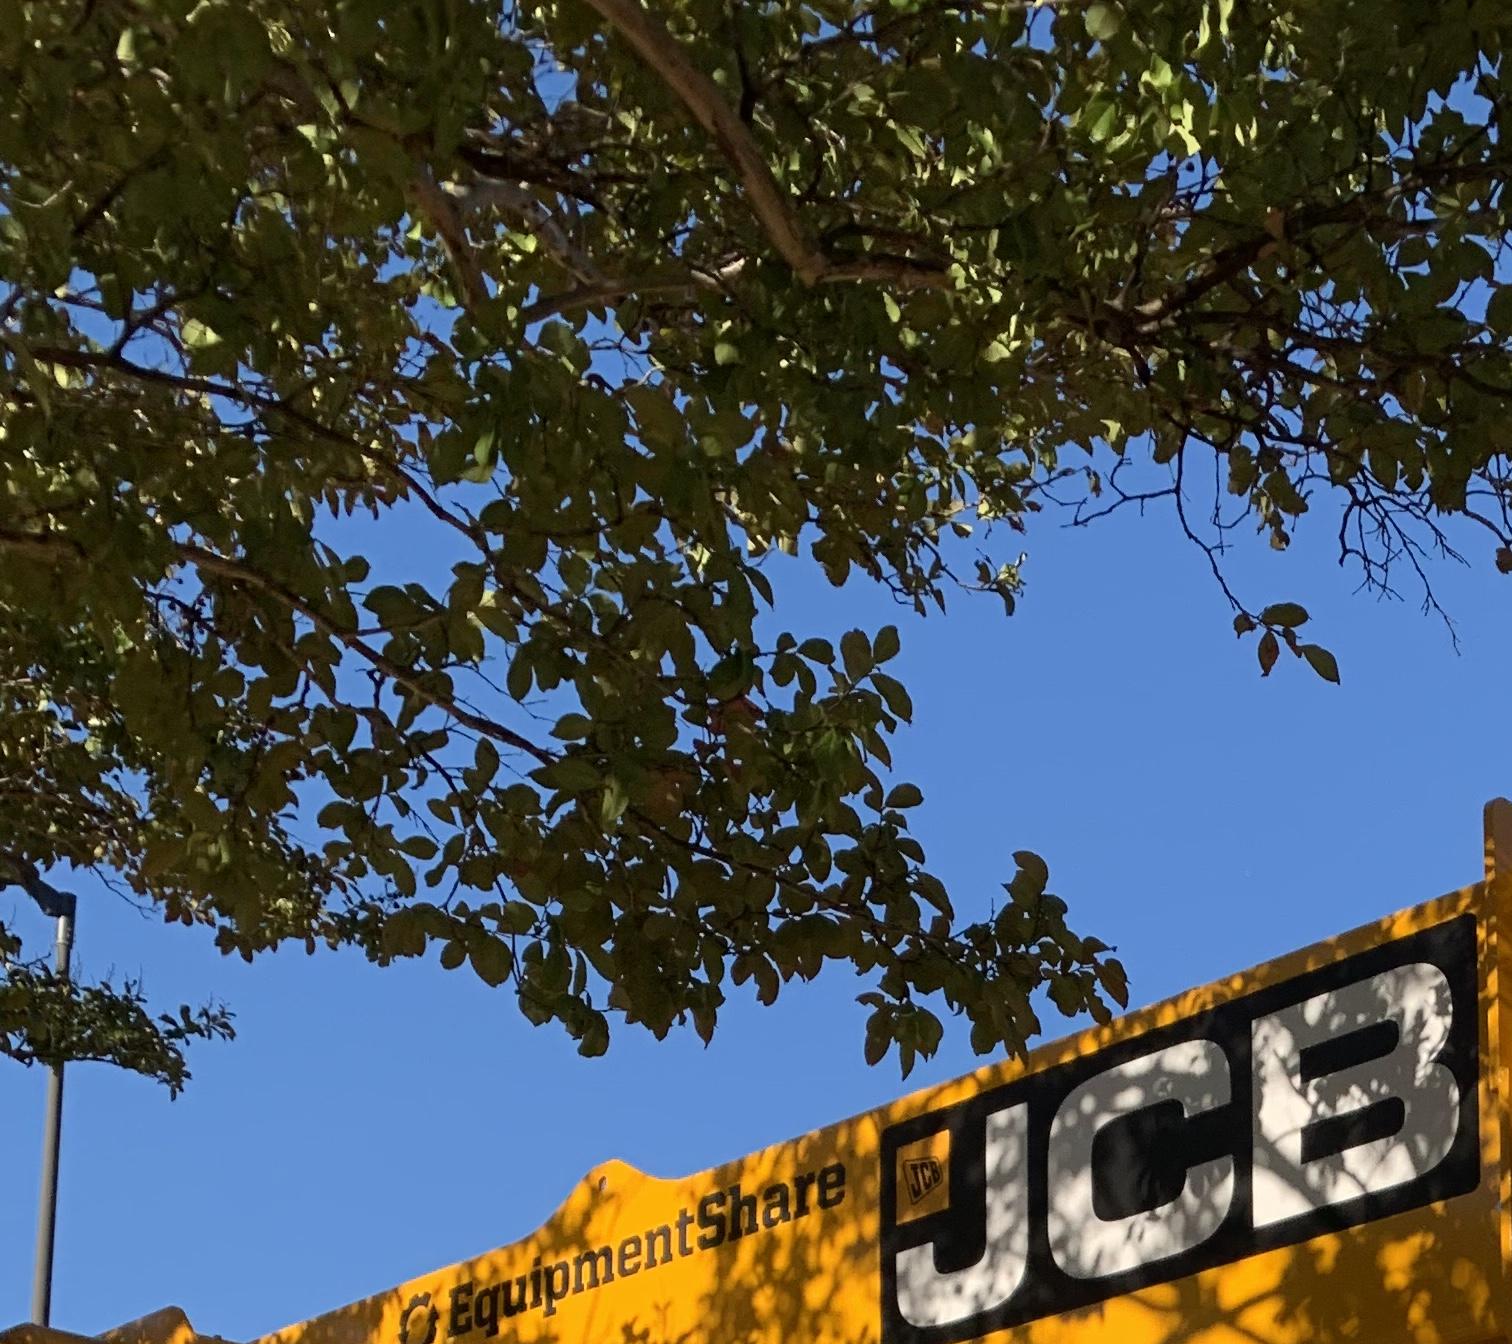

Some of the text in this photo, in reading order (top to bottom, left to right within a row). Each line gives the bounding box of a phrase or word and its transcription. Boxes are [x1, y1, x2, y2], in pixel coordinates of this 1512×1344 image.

[896, 962, 1460, 1328] JCB
[909, 1160, 942, 1198] JCB
[447, 1162, 846, 1338] EquipmentShare
